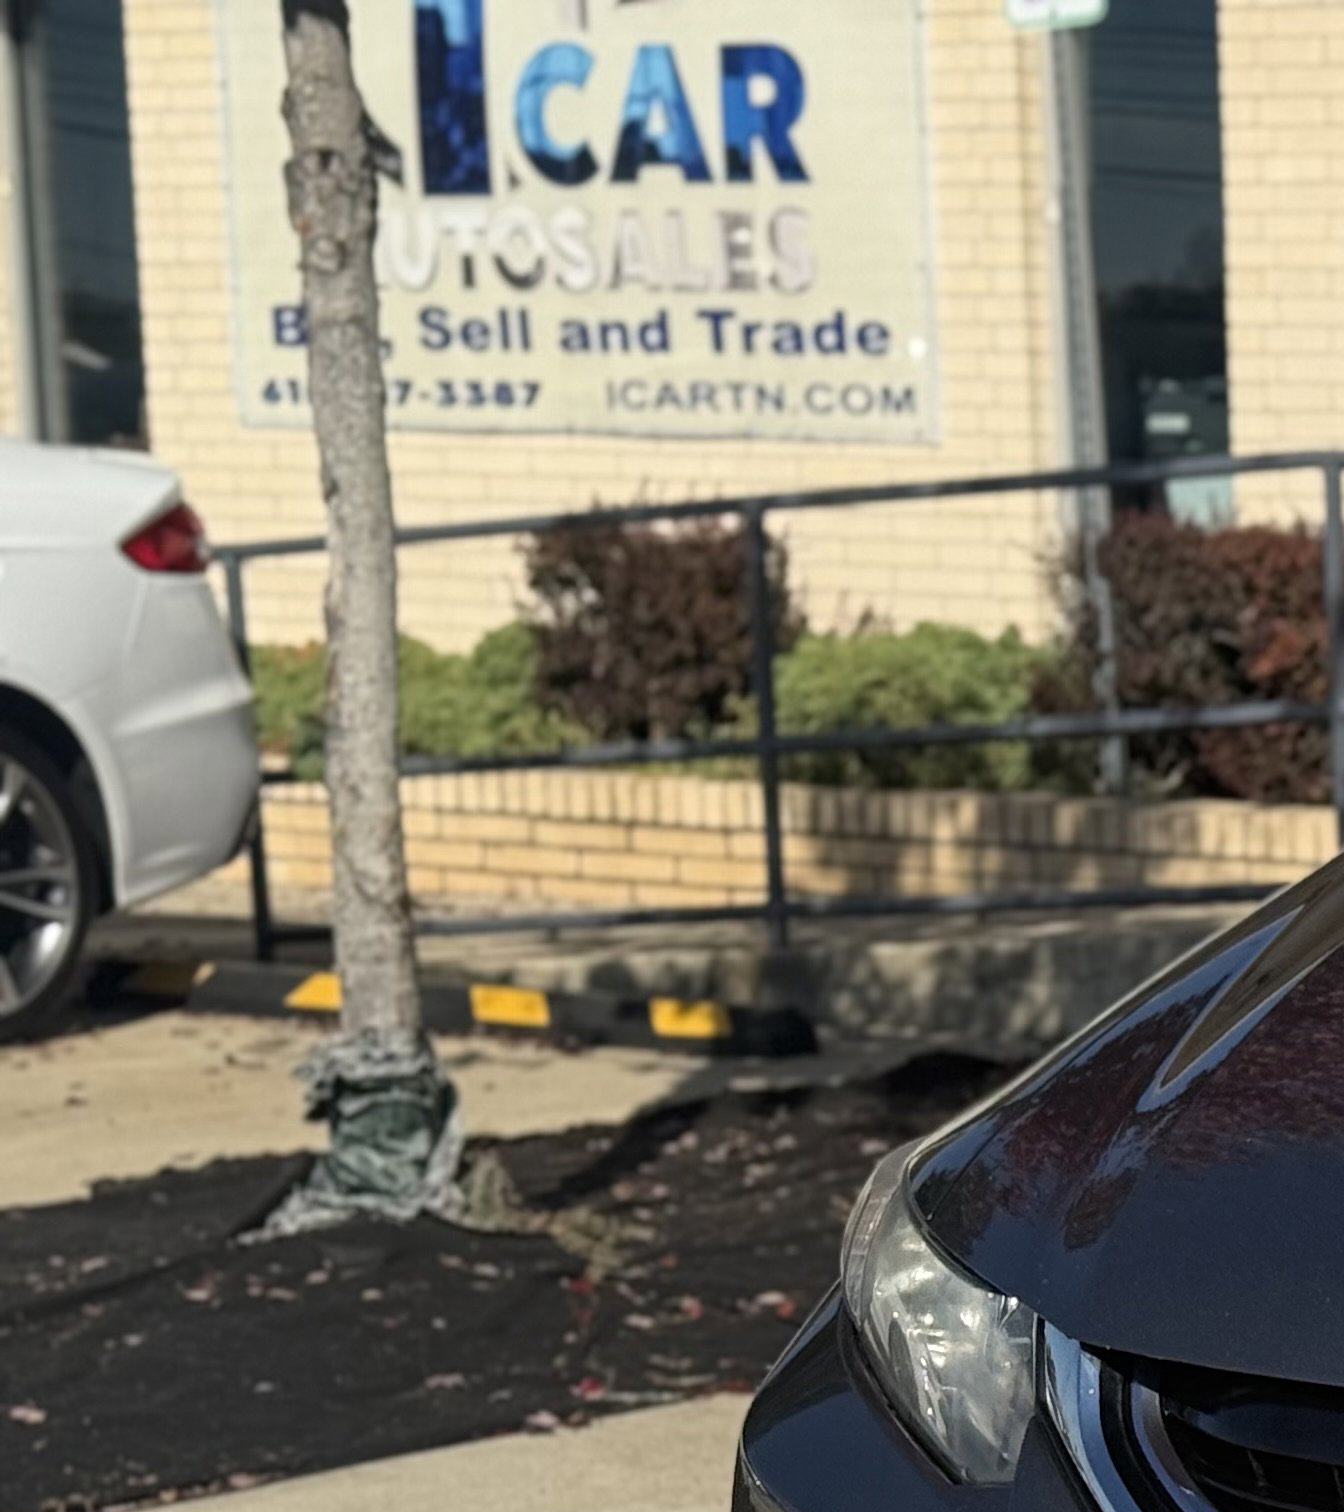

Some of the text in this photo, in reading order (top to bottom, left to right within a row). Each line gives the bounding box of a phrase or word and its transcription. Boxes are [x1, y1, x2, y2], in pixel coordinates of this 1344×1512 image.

[378, 206, 818, 292] UTOSALES
[419, 305, 533, 352] Sell
[560, 309, 671, 354] and
[697, 309, 891, 354] Trade
